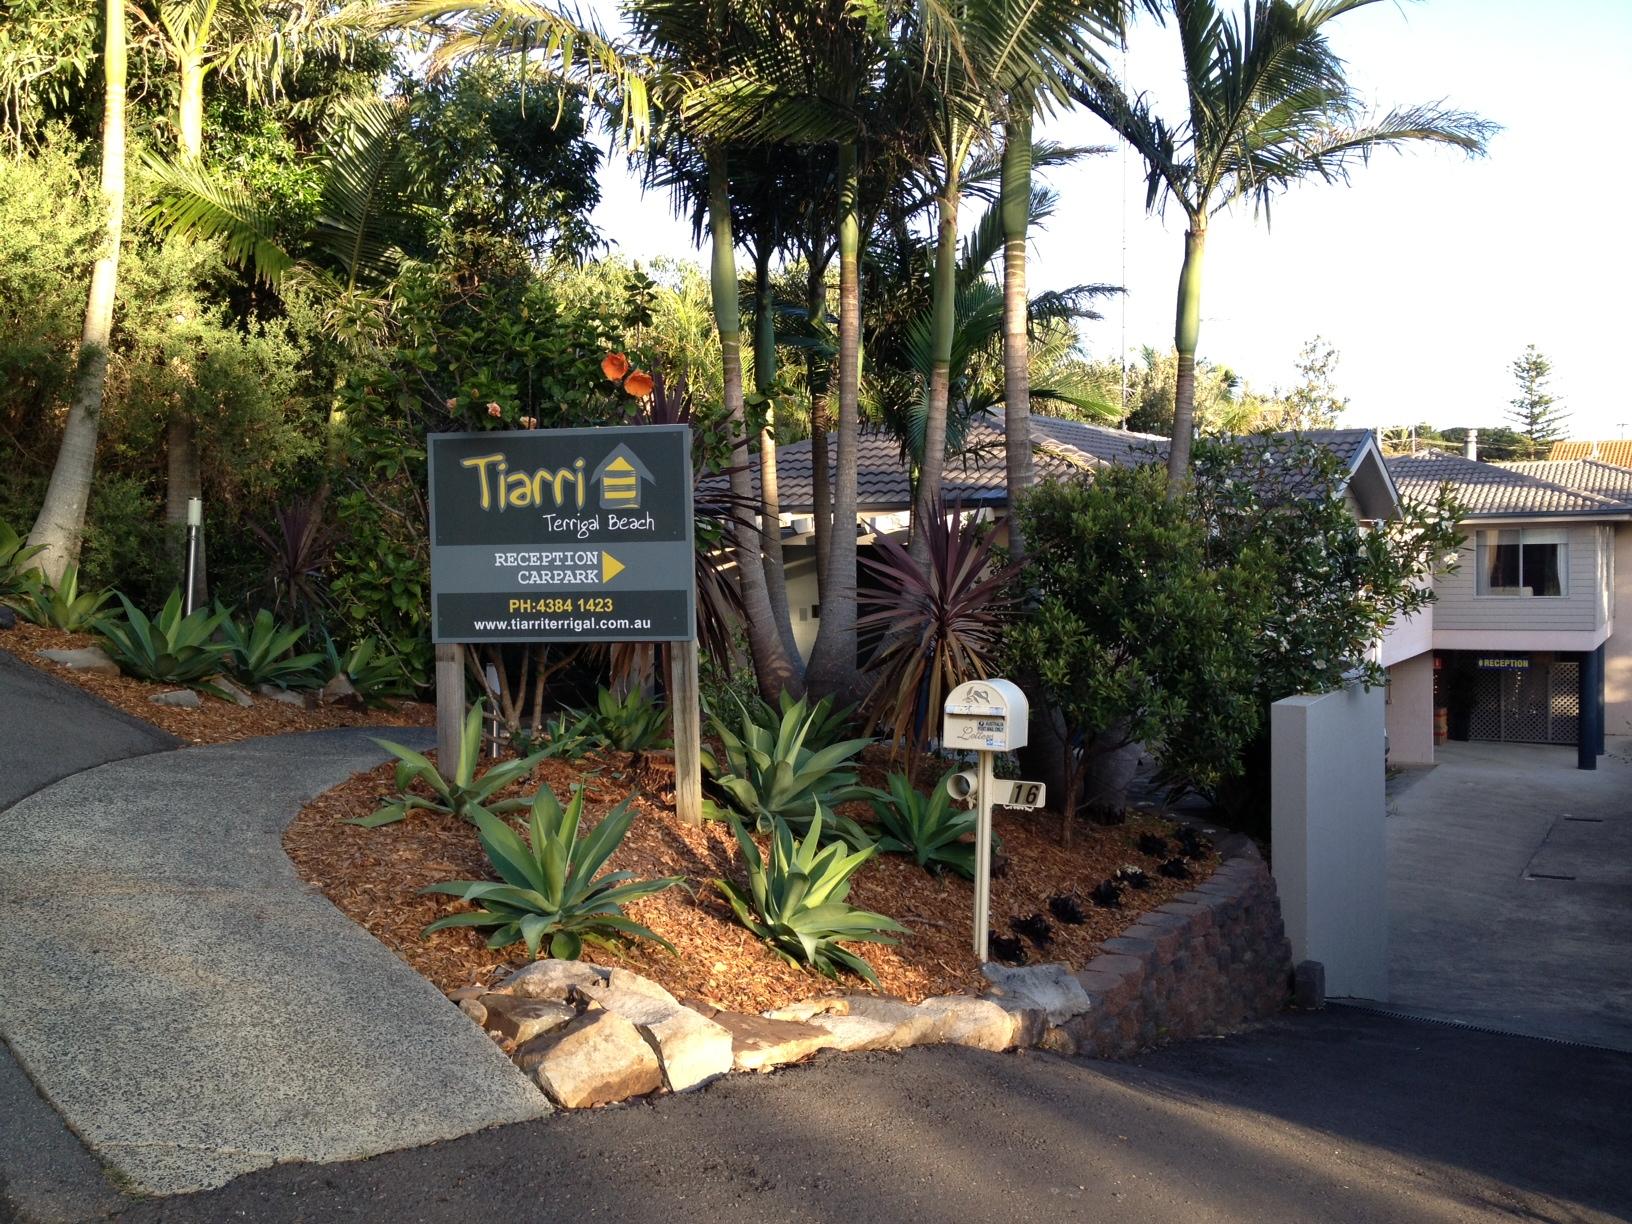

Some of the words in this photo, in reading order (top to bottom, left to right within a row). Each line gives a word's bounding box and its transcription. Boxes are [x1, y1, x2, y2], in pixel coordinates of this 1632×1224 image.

[461, 453, 584, 511] Tiarri
[542, 513, 600, 539] Terrigal
[608, 512, 655, 531] Beach
[494, 551, 599, 567] RECEPTION
[517, 569, 599, 584] CARPARK
[509, 599, 573, 613] PH:4384
[577, 598, 613, 612] 1423
[474, 617, 651, 632] www.tiarriterrigal.com.au
[1484, 659, 1529, 667] RECEPTION
[1014, 783, 1039, 805] 16
